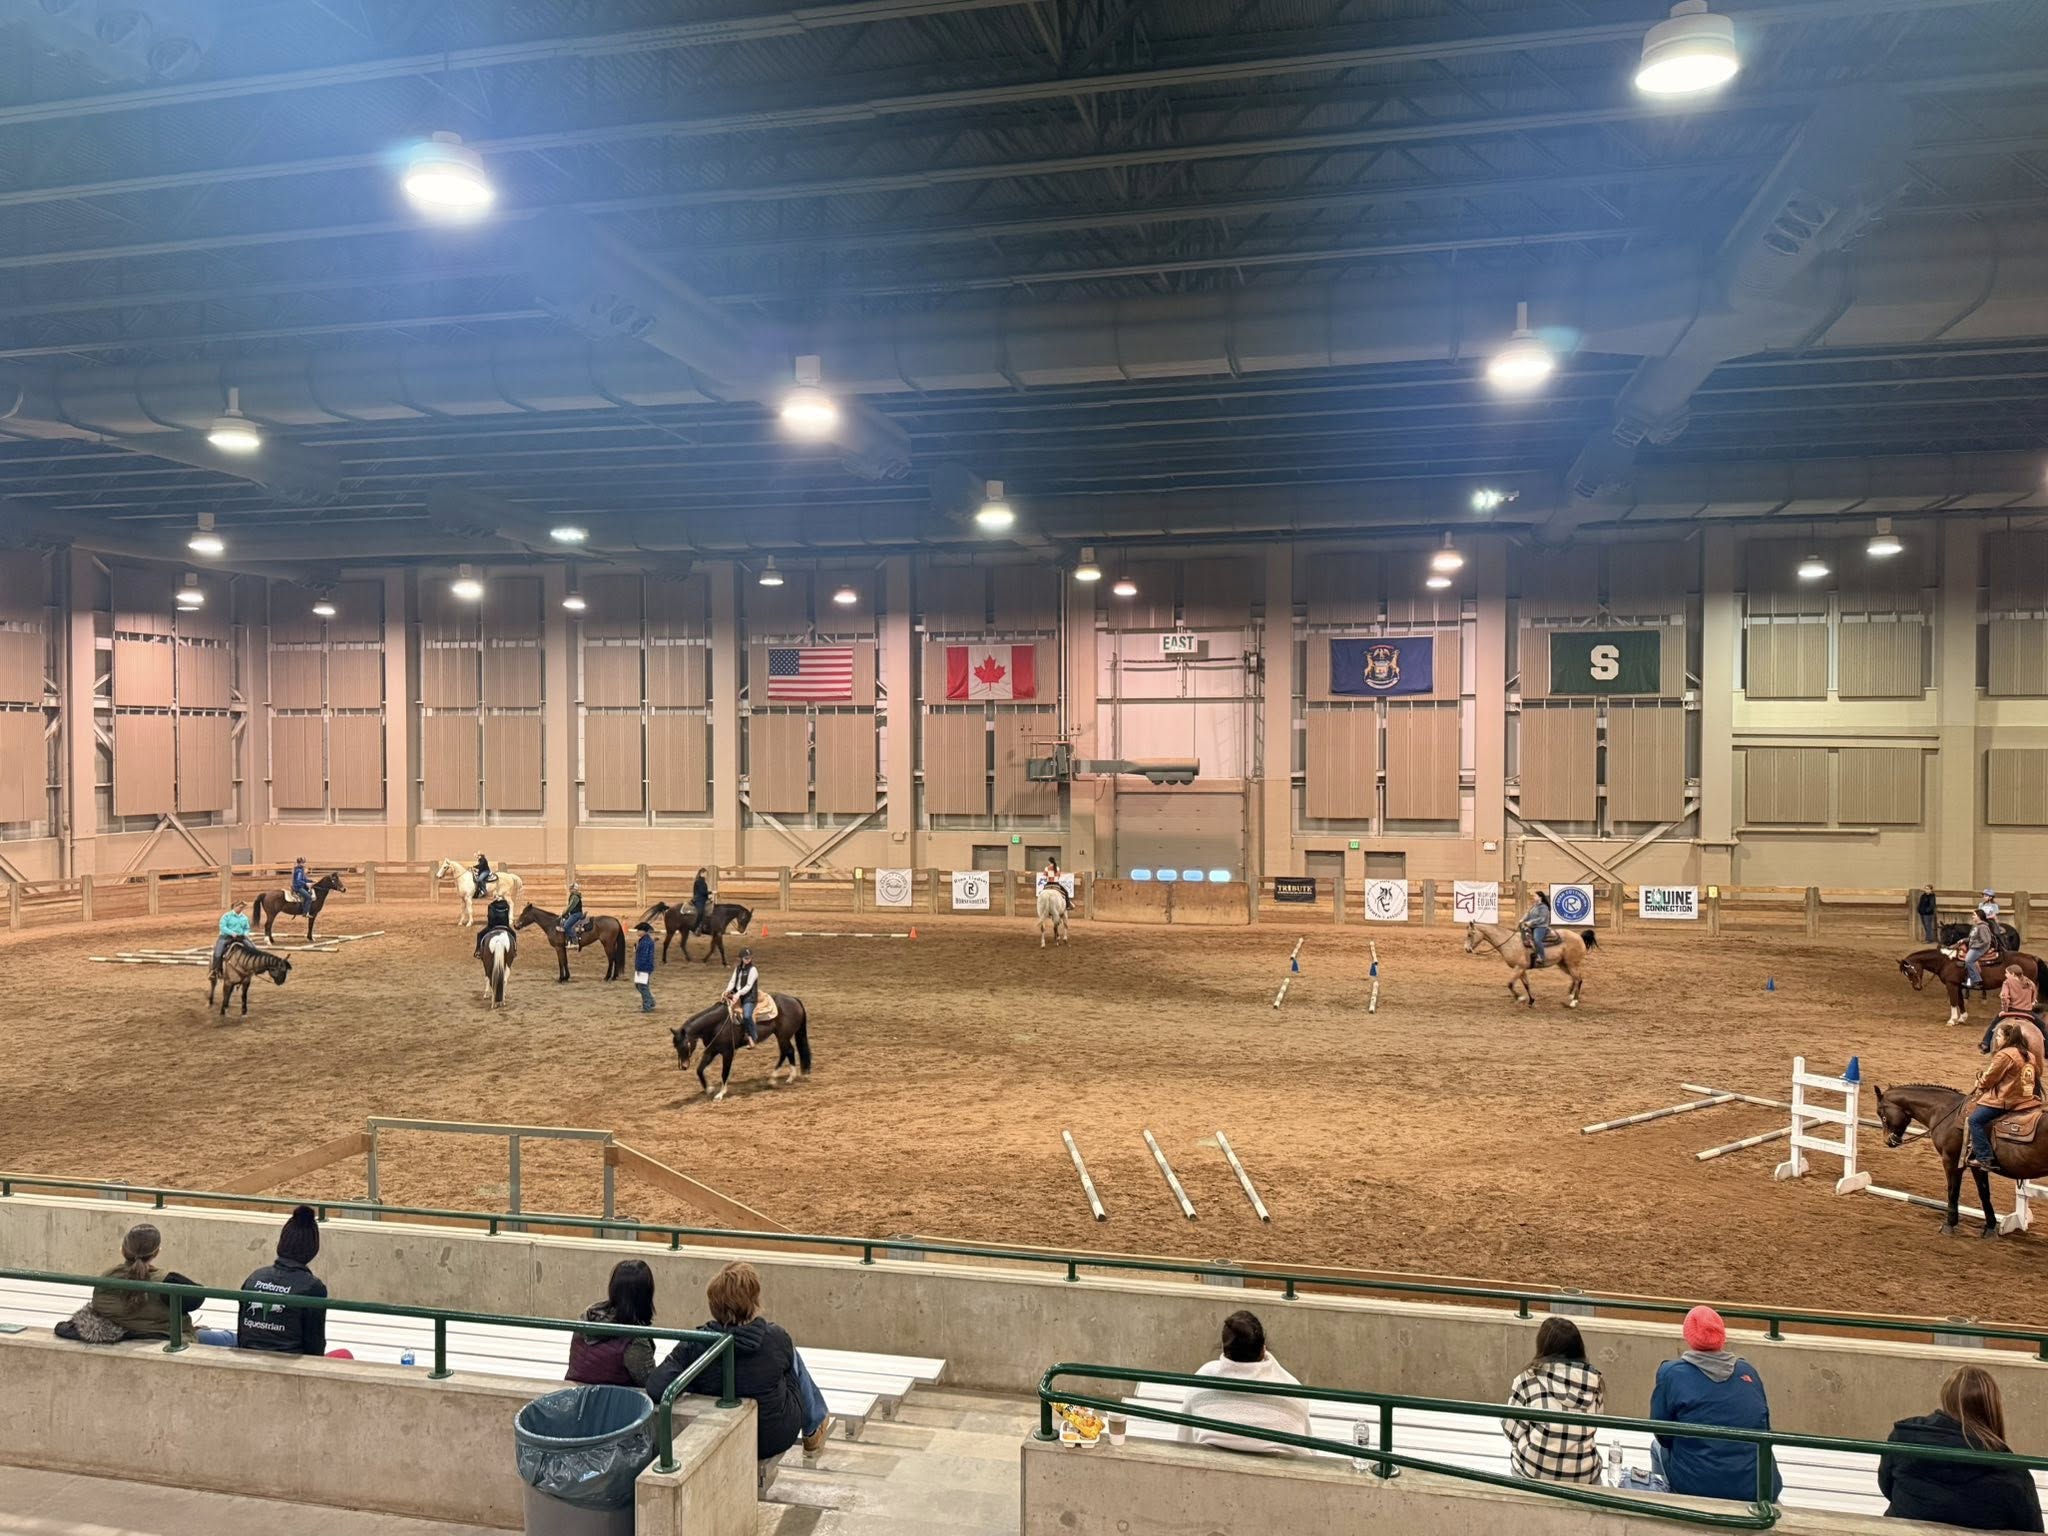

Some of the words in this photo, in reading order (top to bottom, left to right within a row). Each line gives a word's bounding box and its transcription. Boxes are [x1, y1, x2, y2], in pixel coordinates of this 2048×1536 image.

[1163, 636, 1194, 650] EAST
[1591, 645, 1619, 680] S
[1277, 884, 1313, 892] TRIBUTE
[254, 1281, 291, 1294] Preferred
[244, 1318, 285, 1331] Equestrian
